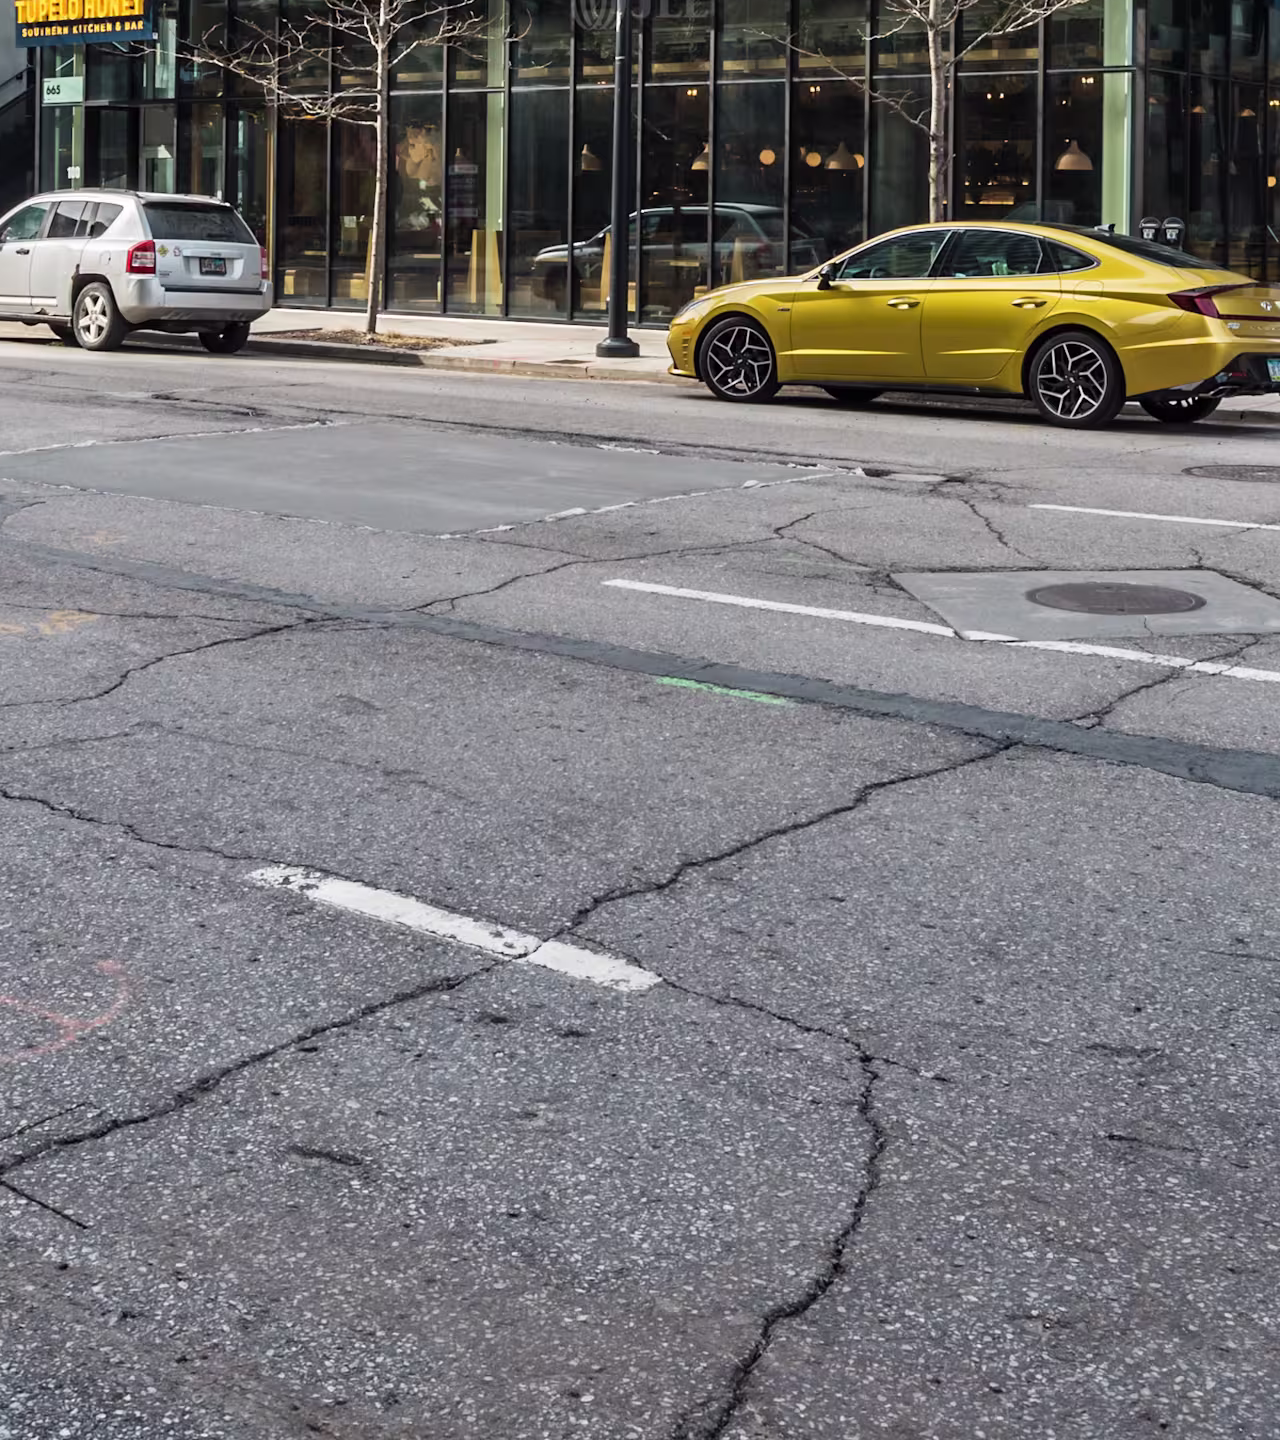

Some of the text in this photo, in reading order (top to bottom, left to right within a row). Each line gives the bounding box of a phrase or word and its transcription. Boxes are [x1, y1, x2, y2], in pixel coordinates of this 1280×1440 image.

[22, 20, 144, 37] SOUTHERN KITCHEN & BAR
[46, 85, 61, 95] 665
